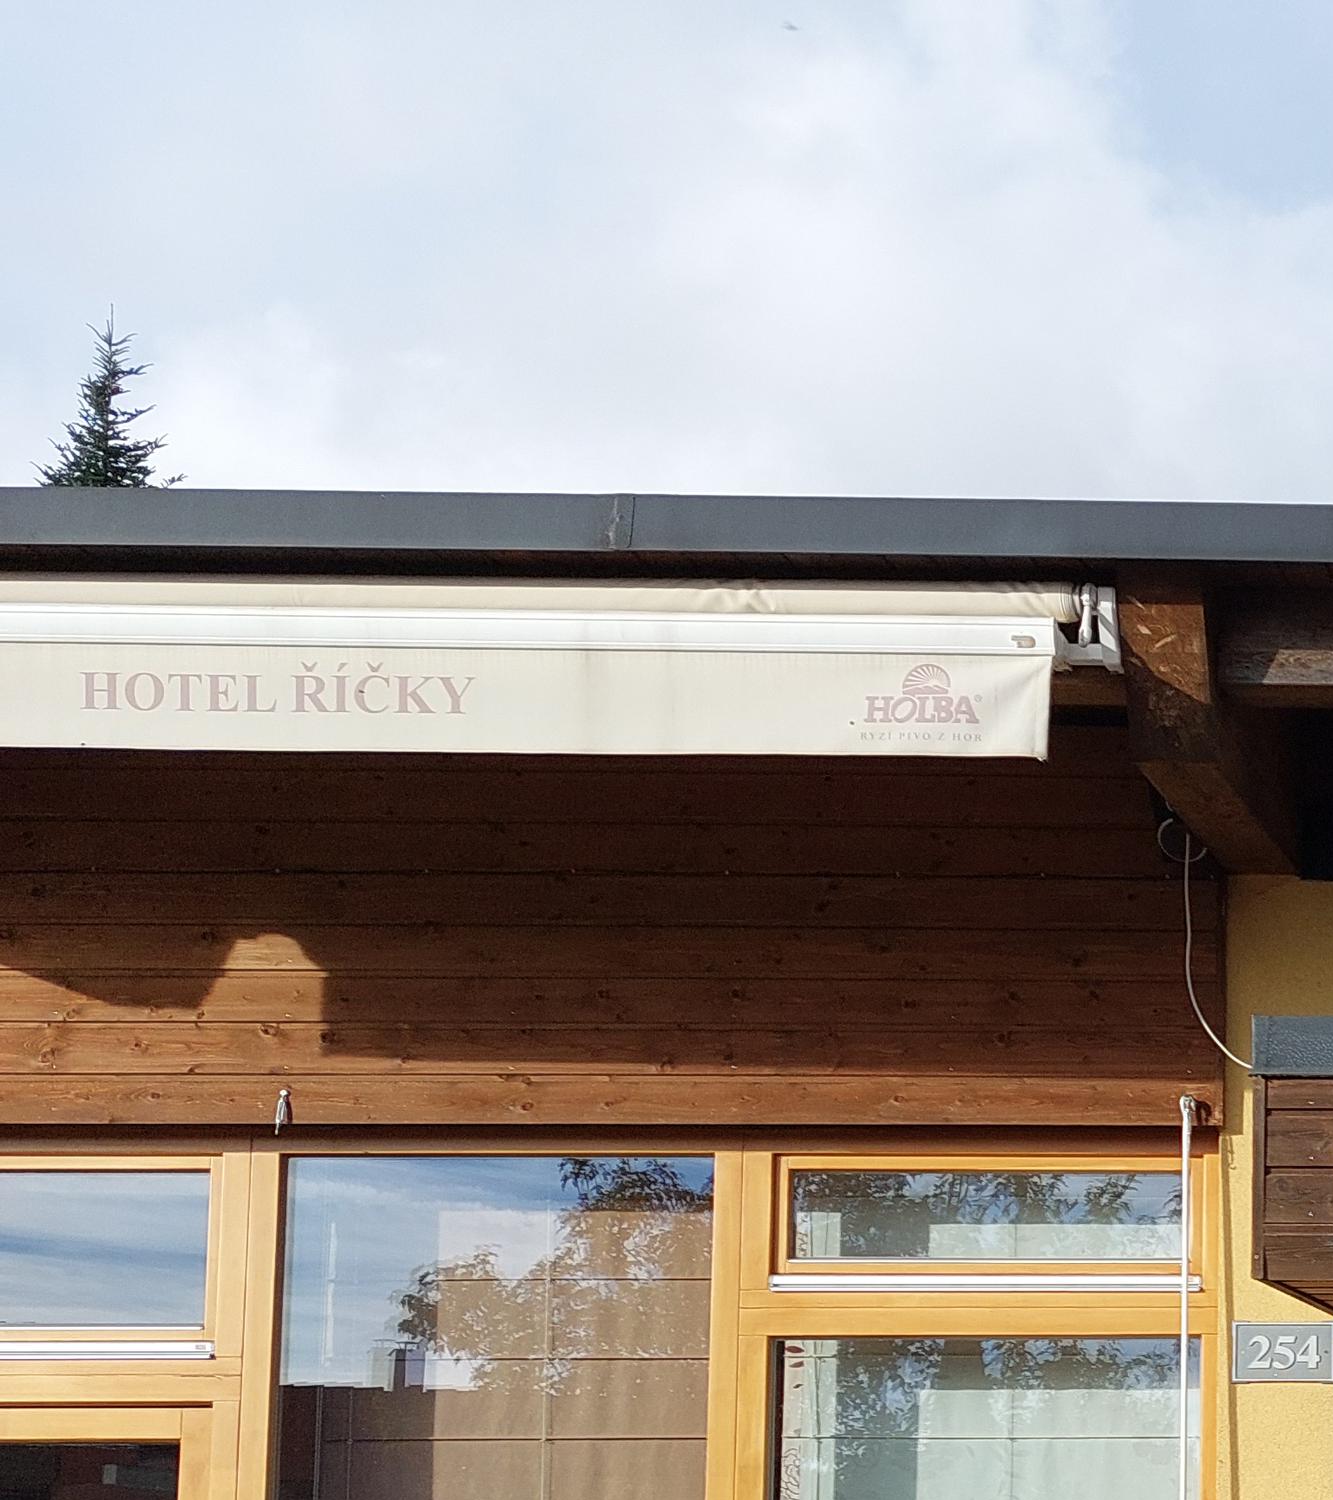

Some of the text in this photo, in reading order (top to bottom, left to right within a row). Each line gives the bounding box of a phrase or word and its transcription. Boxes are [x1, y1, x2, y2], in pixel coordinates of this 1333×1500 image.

[80, 661, 476, 715] HOTEL ŘÍČKY
[863, 695, 980, 725] HOLBA
[952, 732, 982, 742] HOR
[1247, 1334, 1322, 1370] 254
